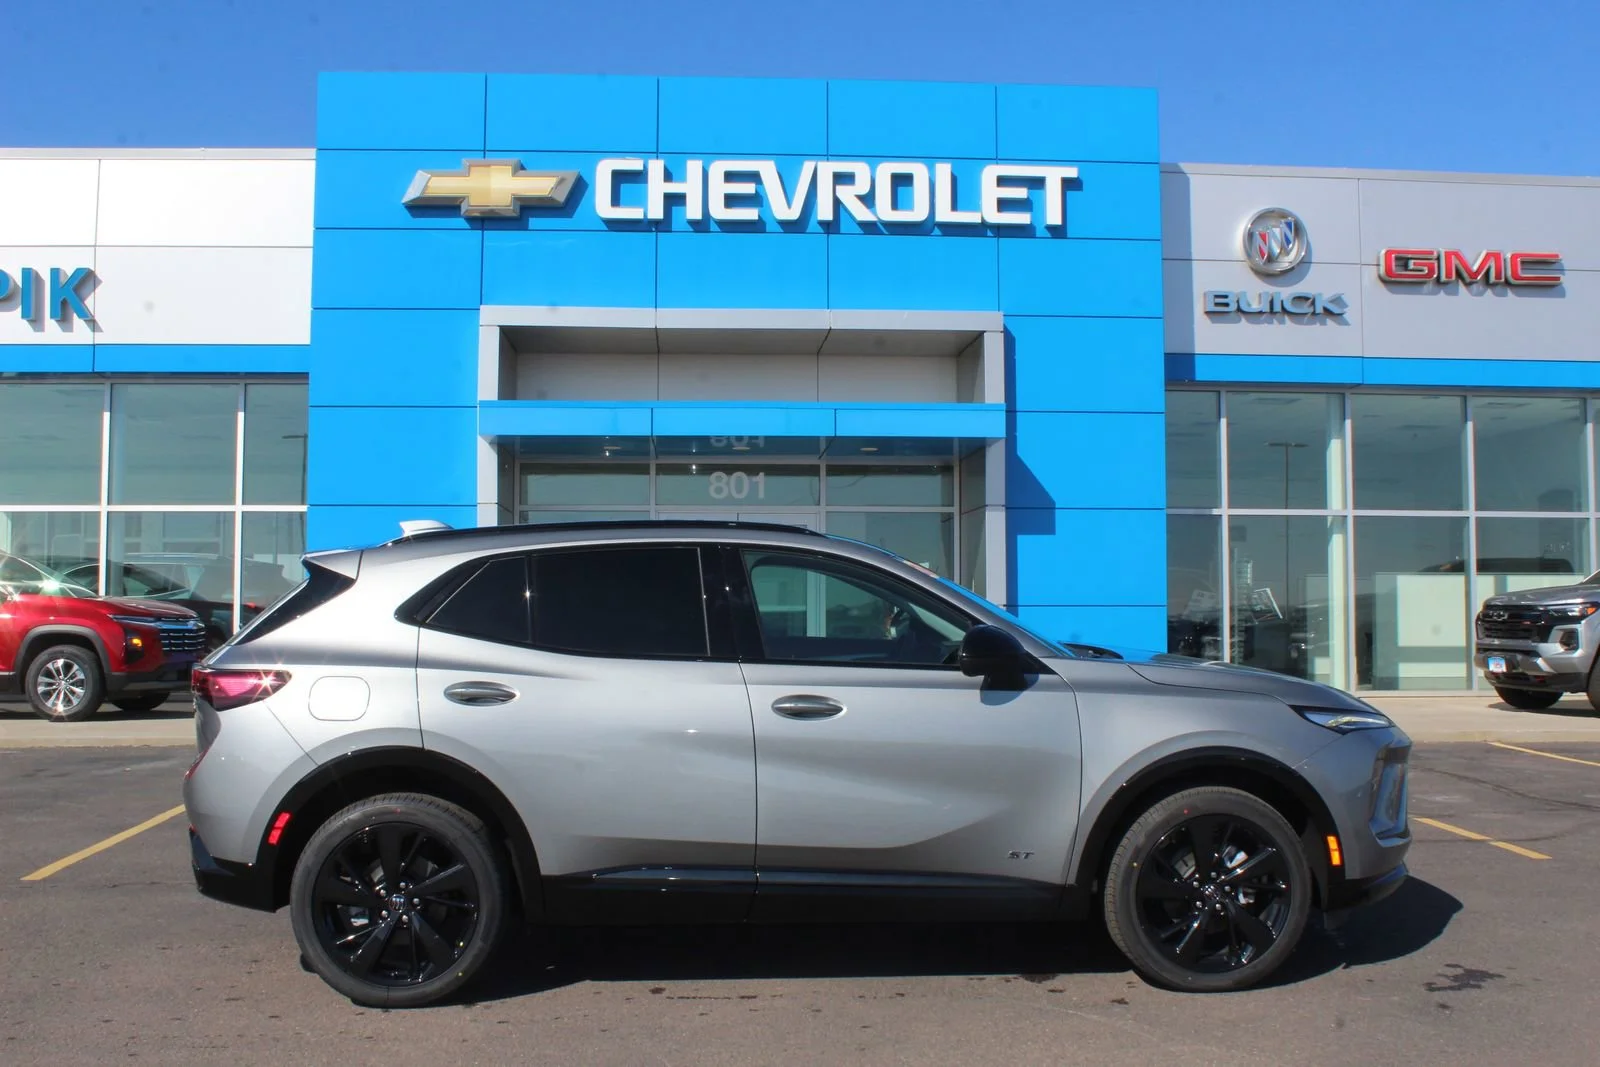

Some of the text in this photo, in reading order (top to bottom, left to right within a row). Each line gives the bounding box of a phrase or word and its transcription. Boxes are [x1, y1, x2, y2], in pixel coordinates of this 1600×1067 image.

[595, 158, 1079, 227] CHEVROLET
[1378, 248, 1563, 286] GMC
[1204, 291, 1346, 315] BUICK
[709, 471, 765, 499] 801
